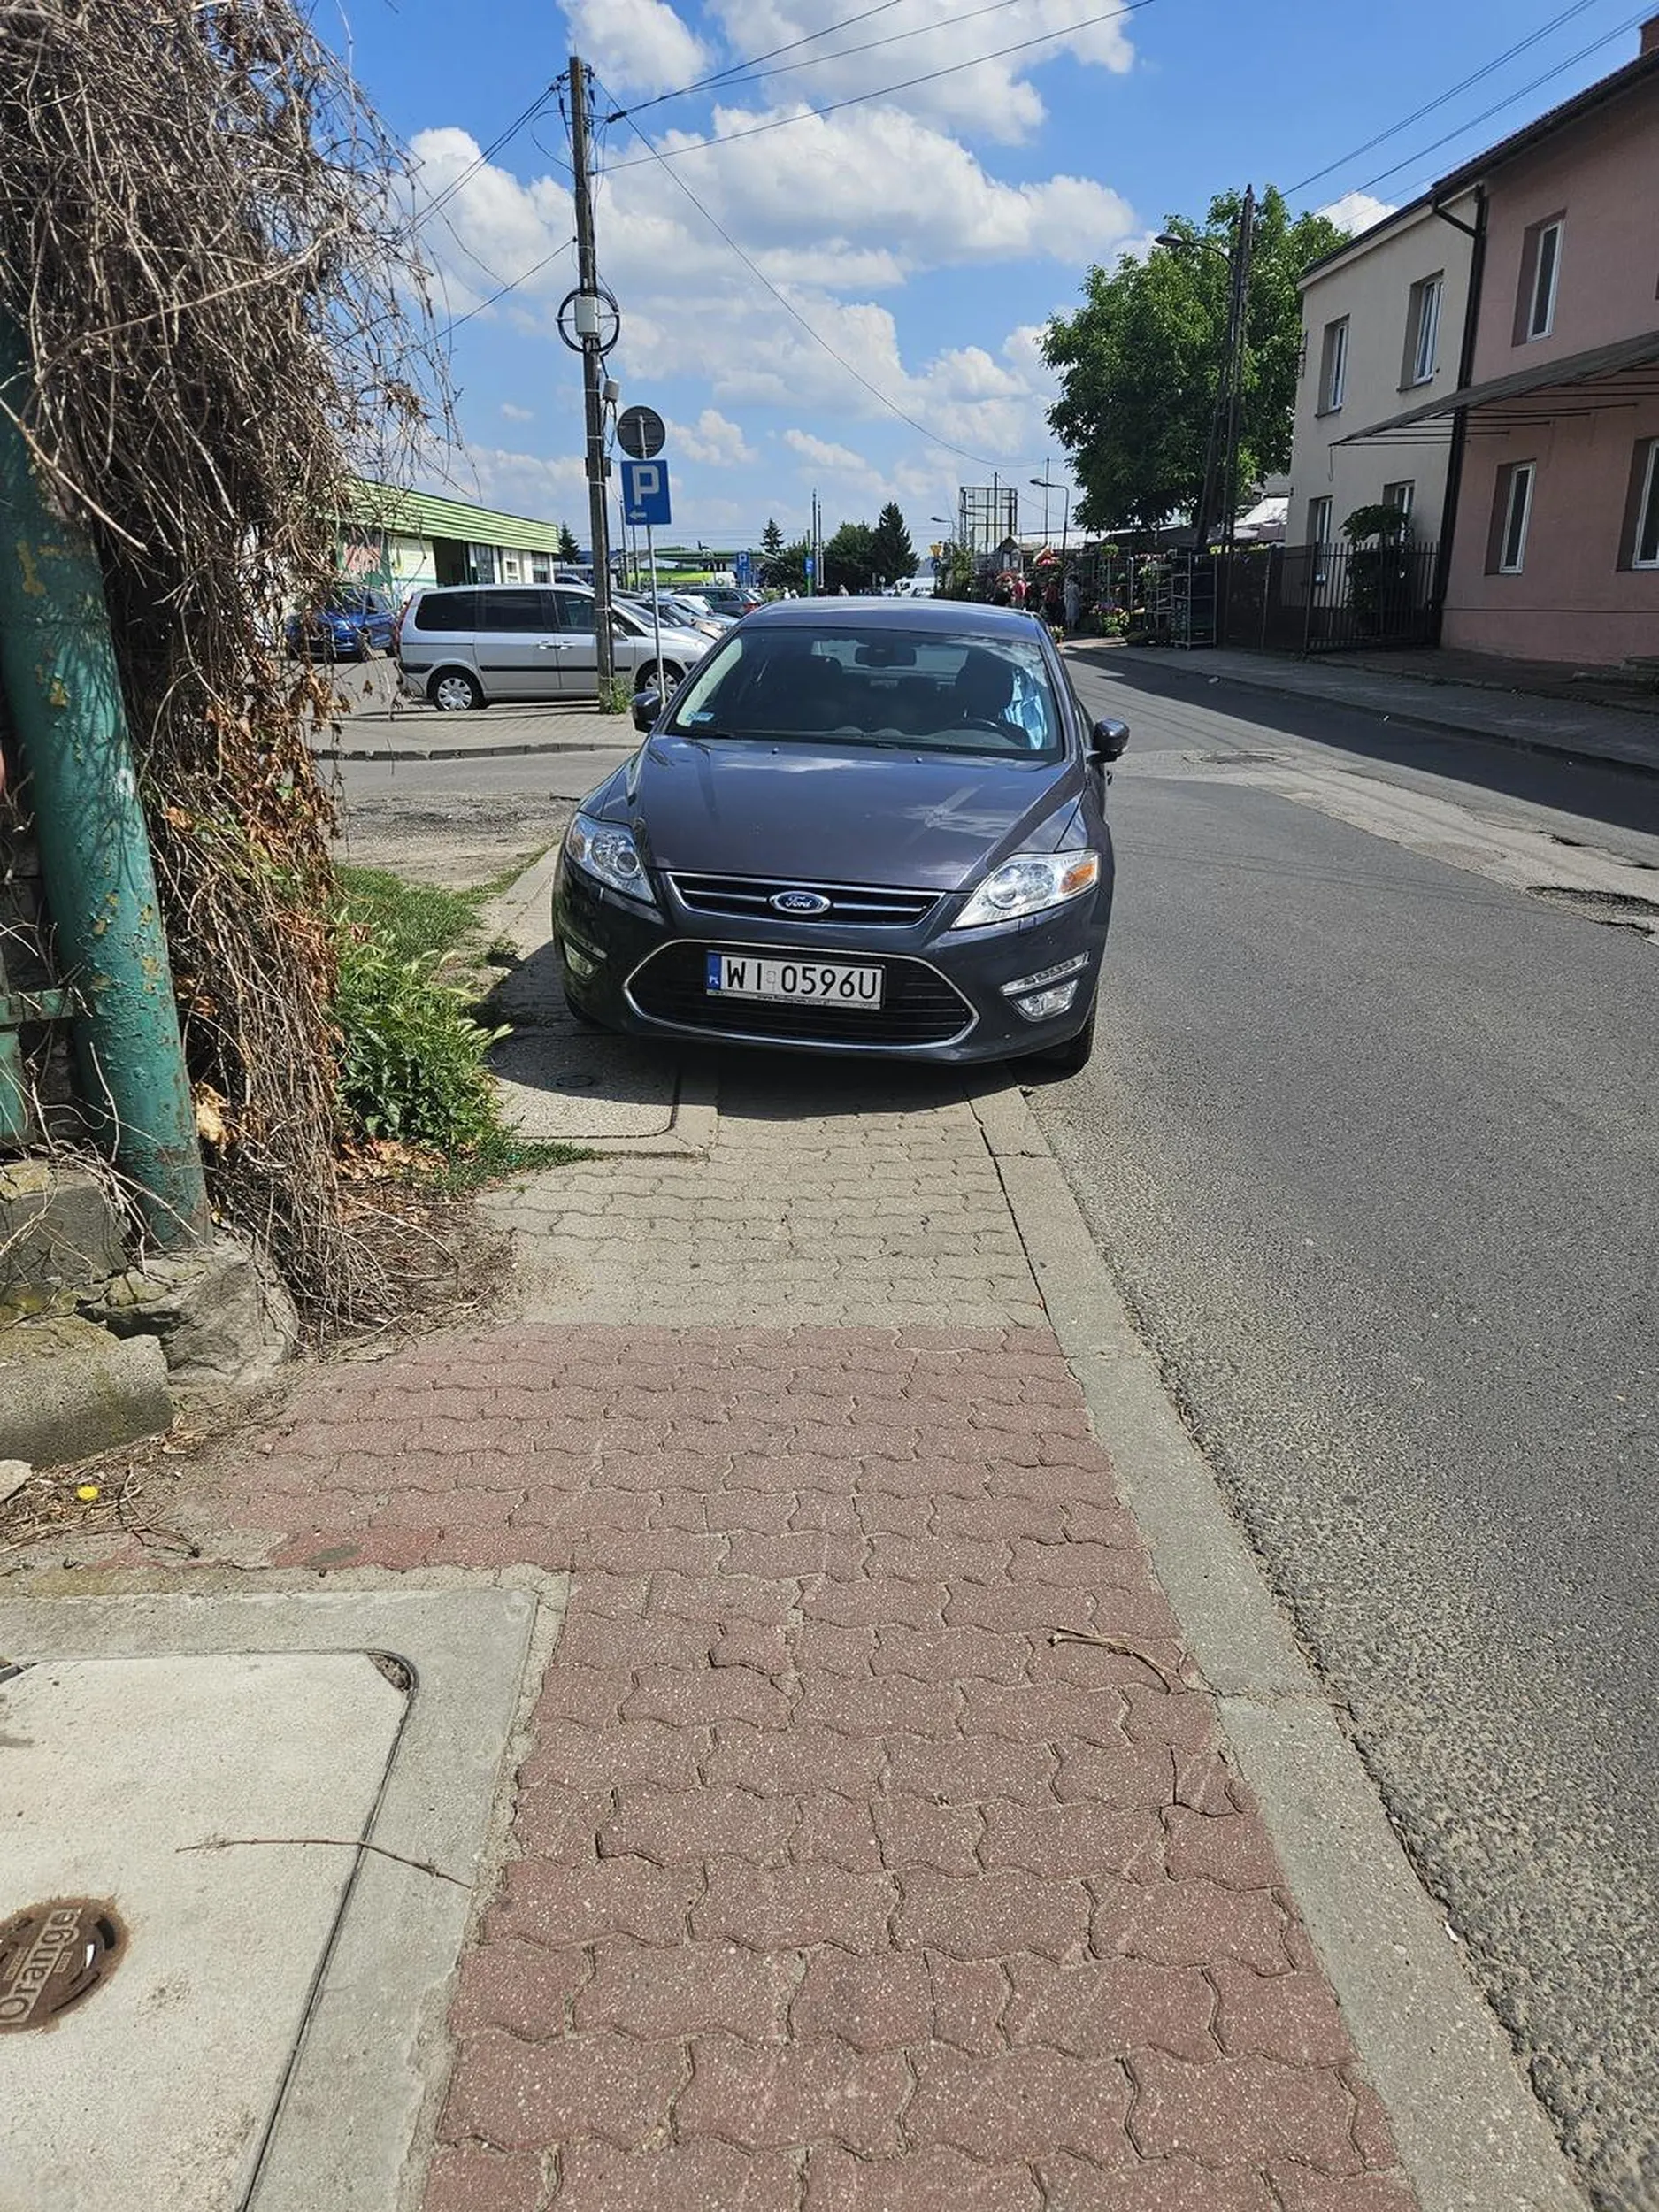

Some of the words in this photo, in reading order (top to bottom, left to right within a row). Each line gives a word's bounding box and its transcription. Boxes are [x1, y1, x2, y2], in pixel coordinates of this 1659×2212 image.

[632, 465, 660, 505] P
[786, 895, 812, 909] Ford
[727, 960, 762, 990] WI
[781, 965, 877, 999] 0596U
[0, 1911, 75, 2020] Orange
